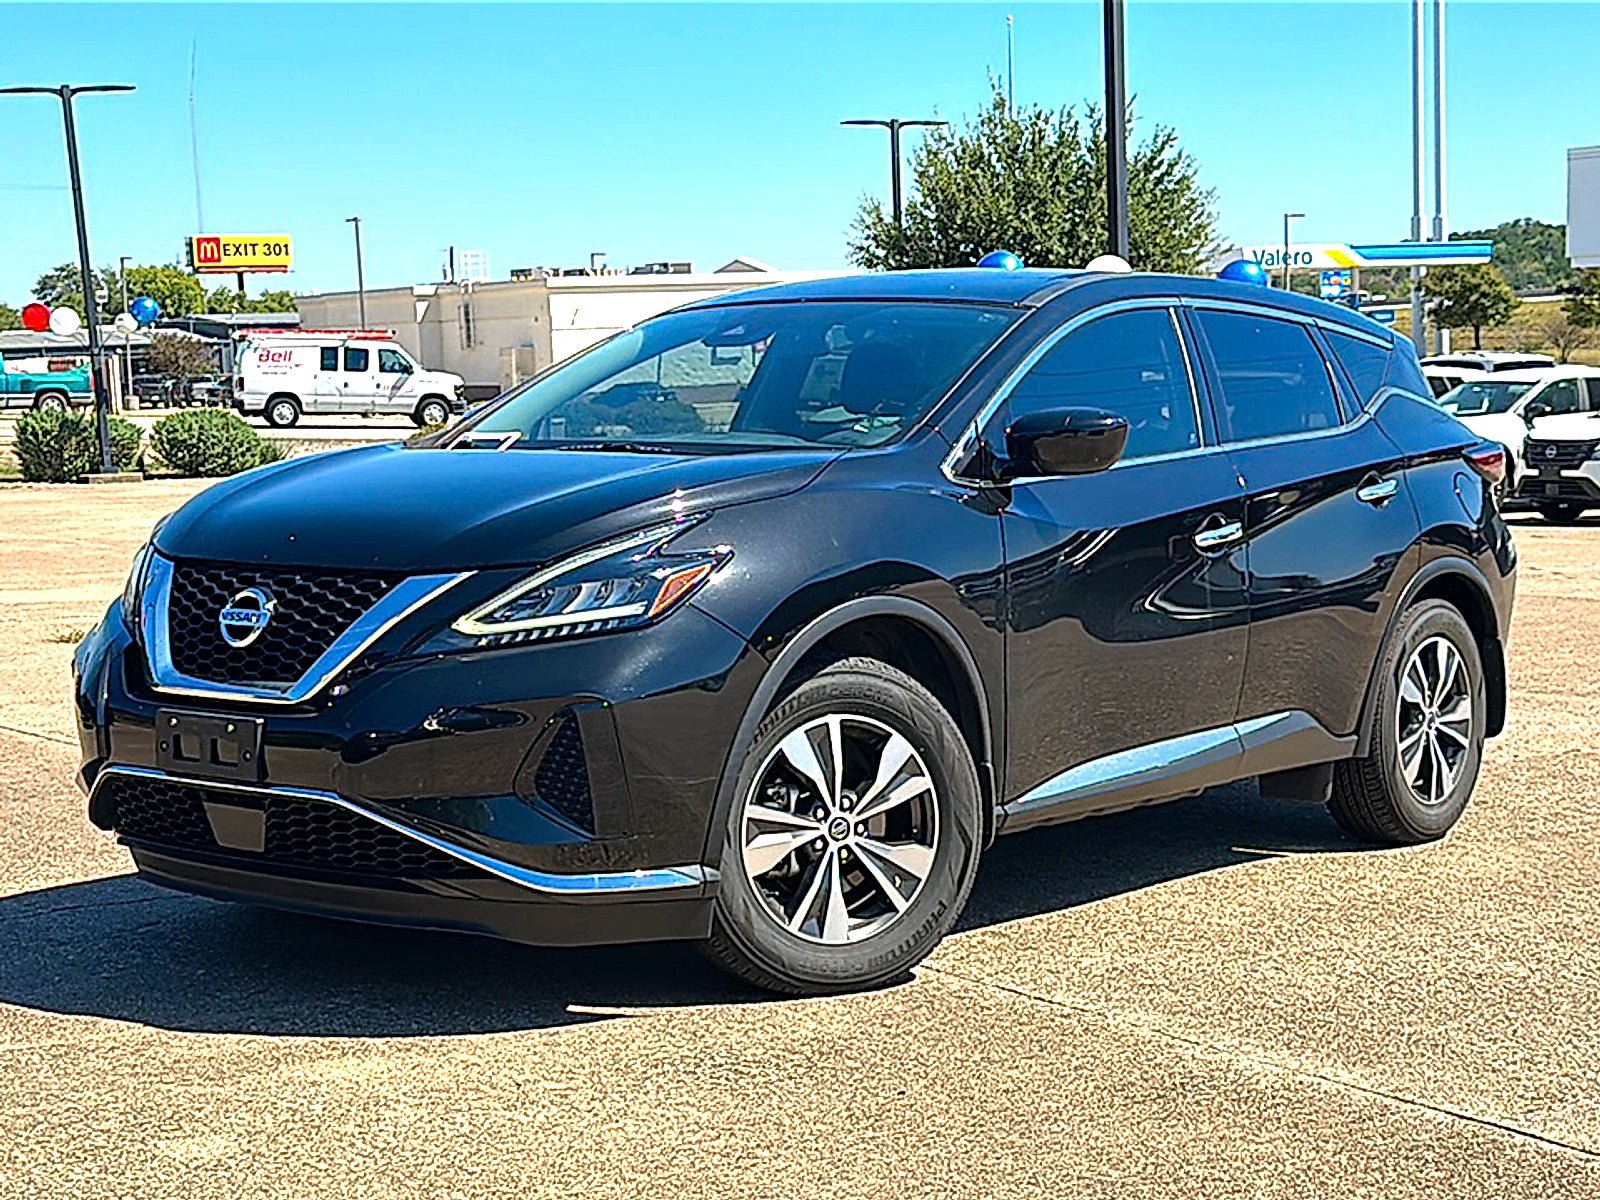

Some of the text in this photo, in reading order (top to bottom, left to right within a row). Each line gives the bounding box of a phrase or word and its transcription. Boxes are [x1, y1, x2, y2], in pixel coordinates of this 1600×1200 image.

[222, 243, 259, 256] EXIT
[263, 243, 289, 256] 301
[1252, 249, 1313, 266] Valero
[258, 348, 293, 362] Bell
